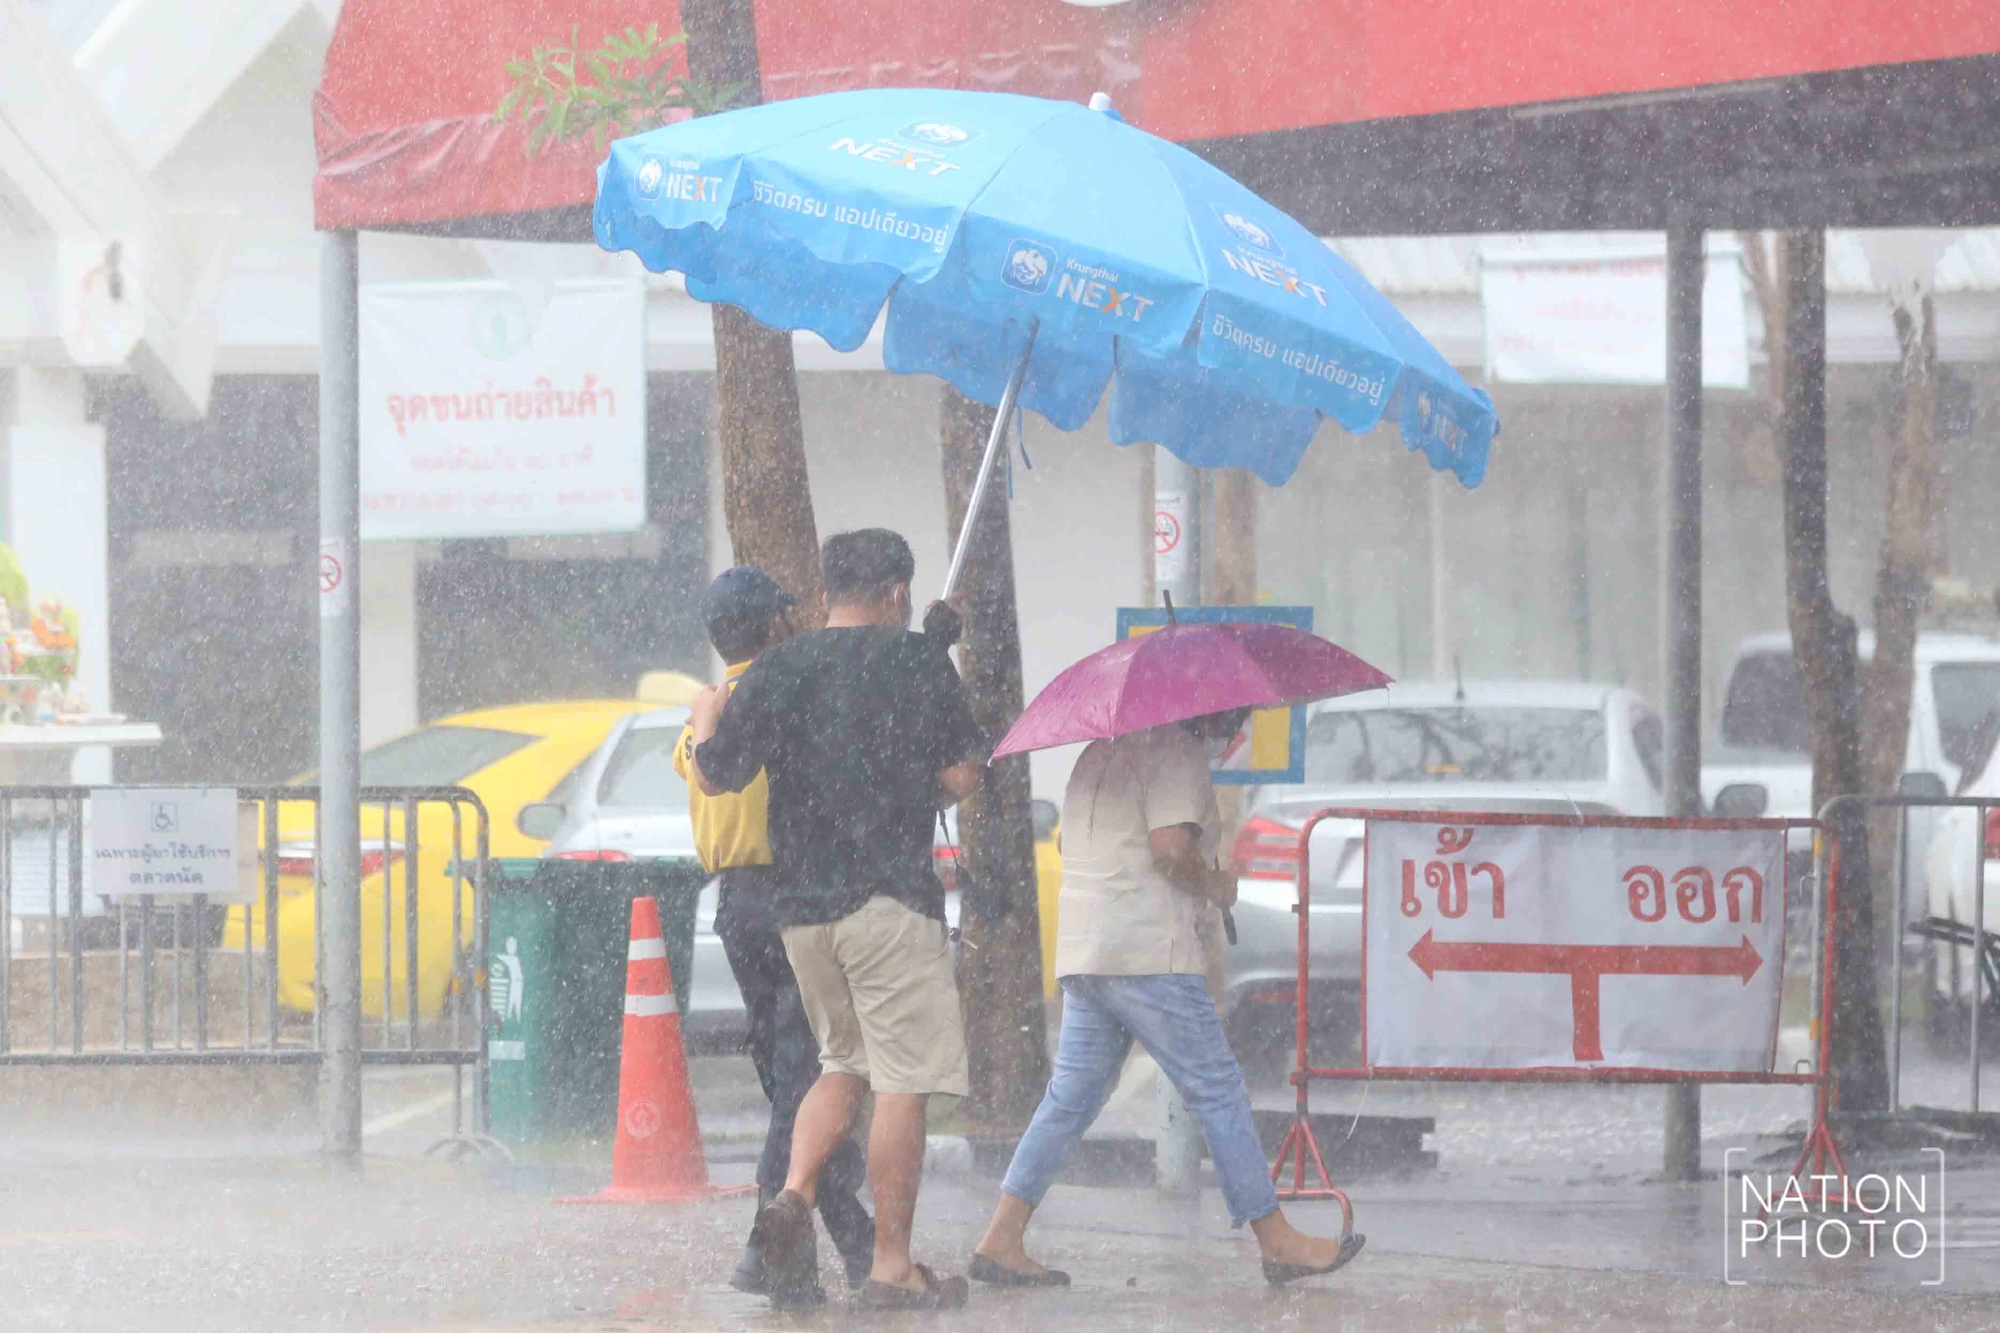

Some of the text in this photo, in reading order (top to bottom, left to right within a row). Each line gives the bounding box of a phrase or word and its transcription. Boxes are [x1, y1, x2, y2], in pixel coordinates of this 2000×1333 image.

[830, 137, 961, 176] NEXT
[665, 172, 724, 203] NEXT
[753, 179, 949, 253] ชีวิตครบ แอปเดียวอยู่
[1056, 273, 1155, 323] NEXT
[1066, 256, 1120, 283] Krungthai
[1220, 248, 1328, 307] NEXT
[1213, 313, 1387, 406] ชีวิตครบ แอปเดียวอยู่
[387, 373, 617, 437] จุดขนถ่ายสินค้า
[128, 865, 204, 884] ตลาดนัด
[1401, 826, 1506, 920] เข้า
[1623, 862, 1764, 924] ออก
